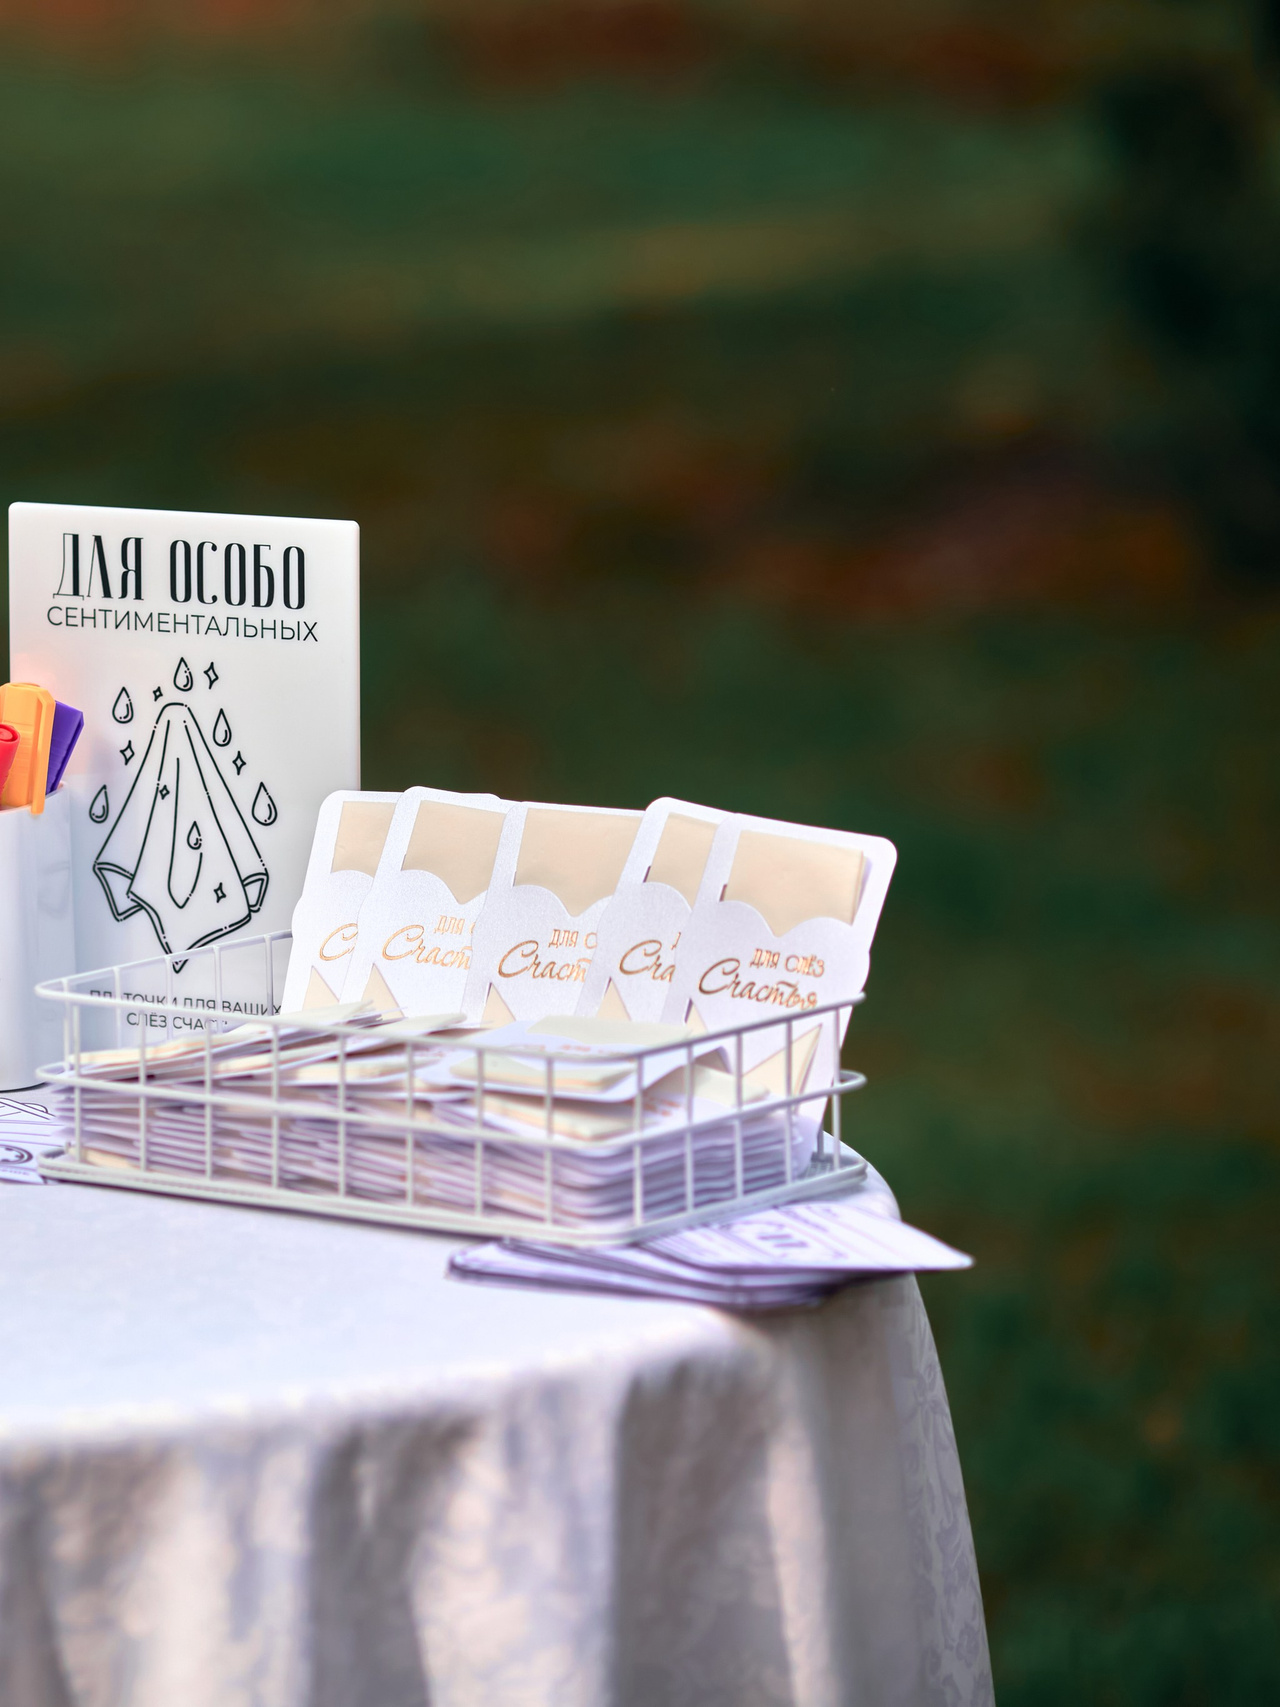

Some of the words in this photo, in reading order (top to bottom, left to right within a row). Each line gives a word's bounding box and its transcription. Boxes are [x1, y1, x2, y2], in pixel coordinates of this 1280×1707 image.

[52, 533, 144, 601] ДЛЯ
[169, 539, 305, 610] ОСОБО
[46, 605, 318, 642] СЕНТИМЕНТАЛЬНЫХ
[382, 924, 472, 970] Счаст
[498, 939, 592, 982] Счаст
[698, 957, 818, 1010] Счастья
